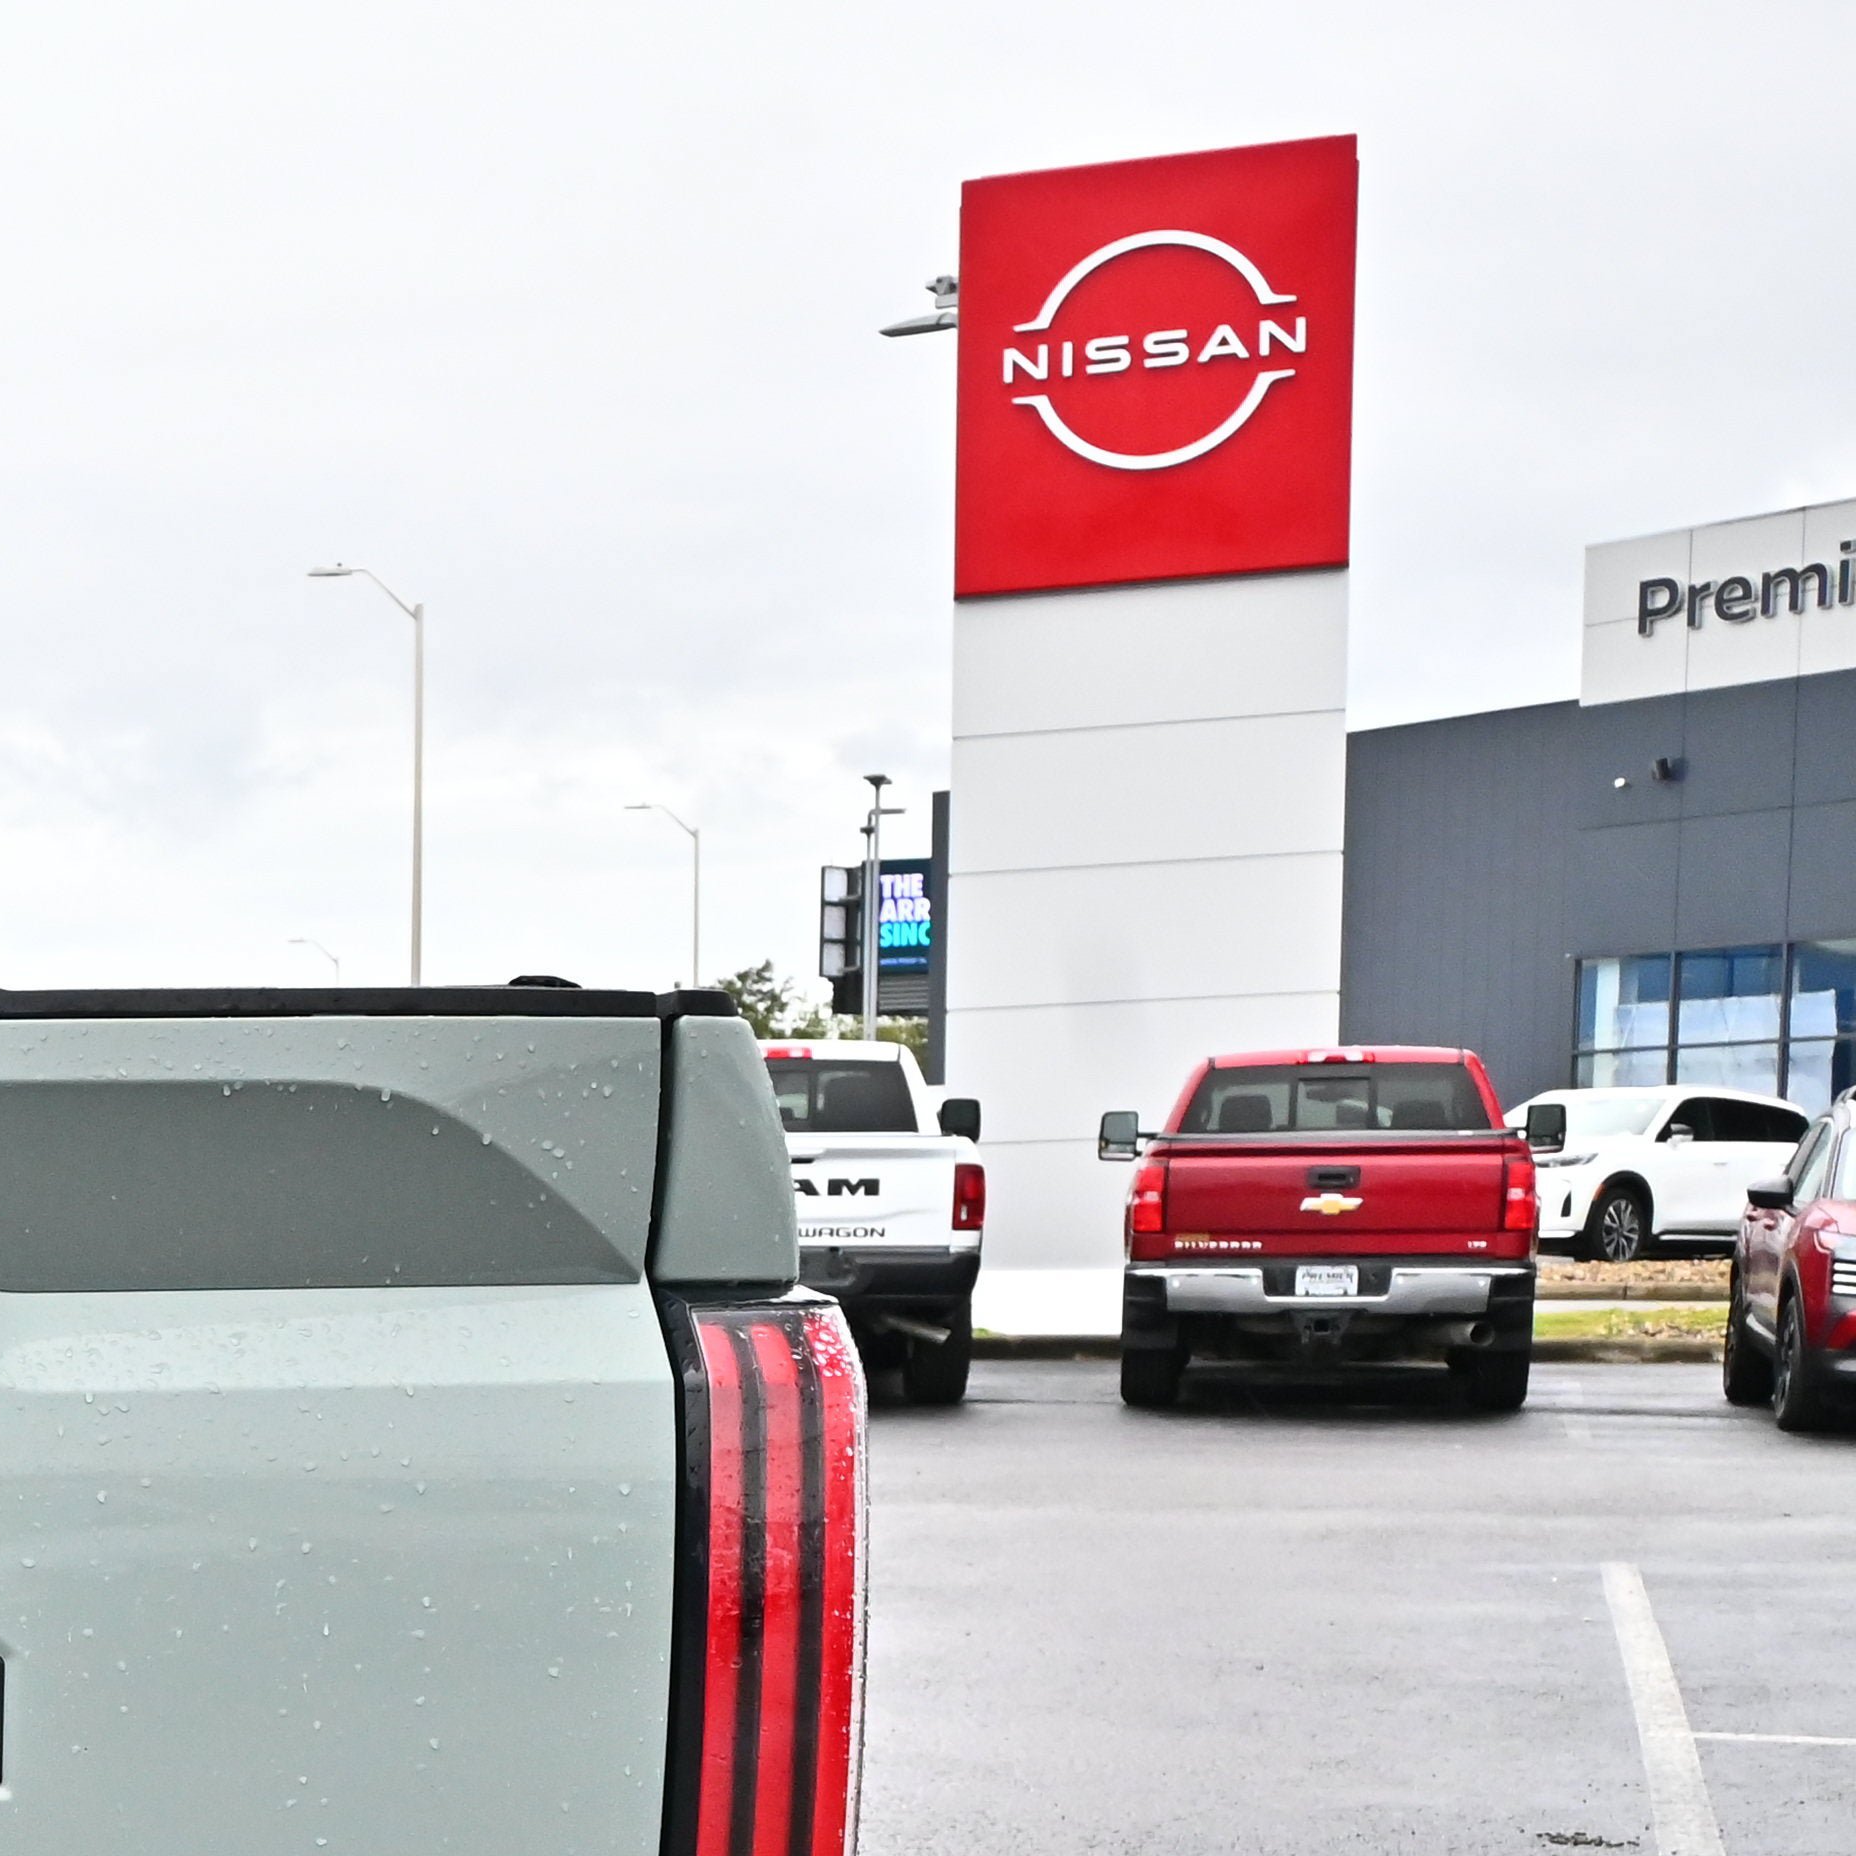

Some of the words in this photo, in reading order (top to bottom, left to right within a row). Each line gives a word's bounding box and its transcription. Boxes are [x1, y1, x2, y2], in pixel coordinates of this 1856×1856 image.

[1002, 316, 1307, 384] NISSAN
[1637, 539, 1856, 638] Premi
[880, 873, 924, 898] THE
[793, 1178, 880, 1196] AM
[798, 1227, 885, 1238] WAGON
